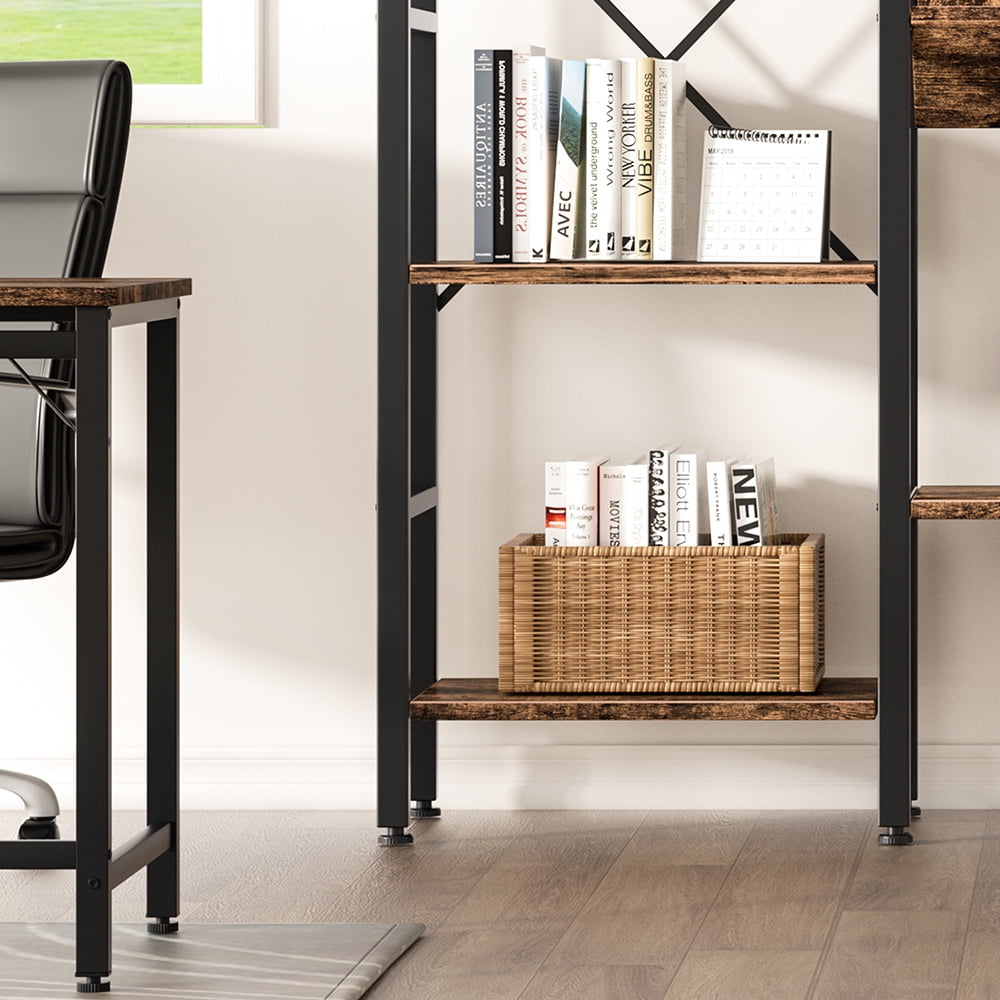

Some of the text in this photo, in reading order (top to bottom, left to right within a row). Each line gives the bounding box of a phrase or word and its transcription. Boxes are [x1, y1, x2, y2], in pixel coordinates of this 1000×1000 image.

[606, 72, 615, 186] Wrong World
[622, 102, 636, 188] NEW YORKER
[638, 72, 652, 196] VIBE DRUM&BASS
[556, 190, 572, 238] AVEC
[590, 122, 599, 228] the velvet underground
[610, 500, 620, 546] MOVIES
[676, 460, 690, 512] Elliott
